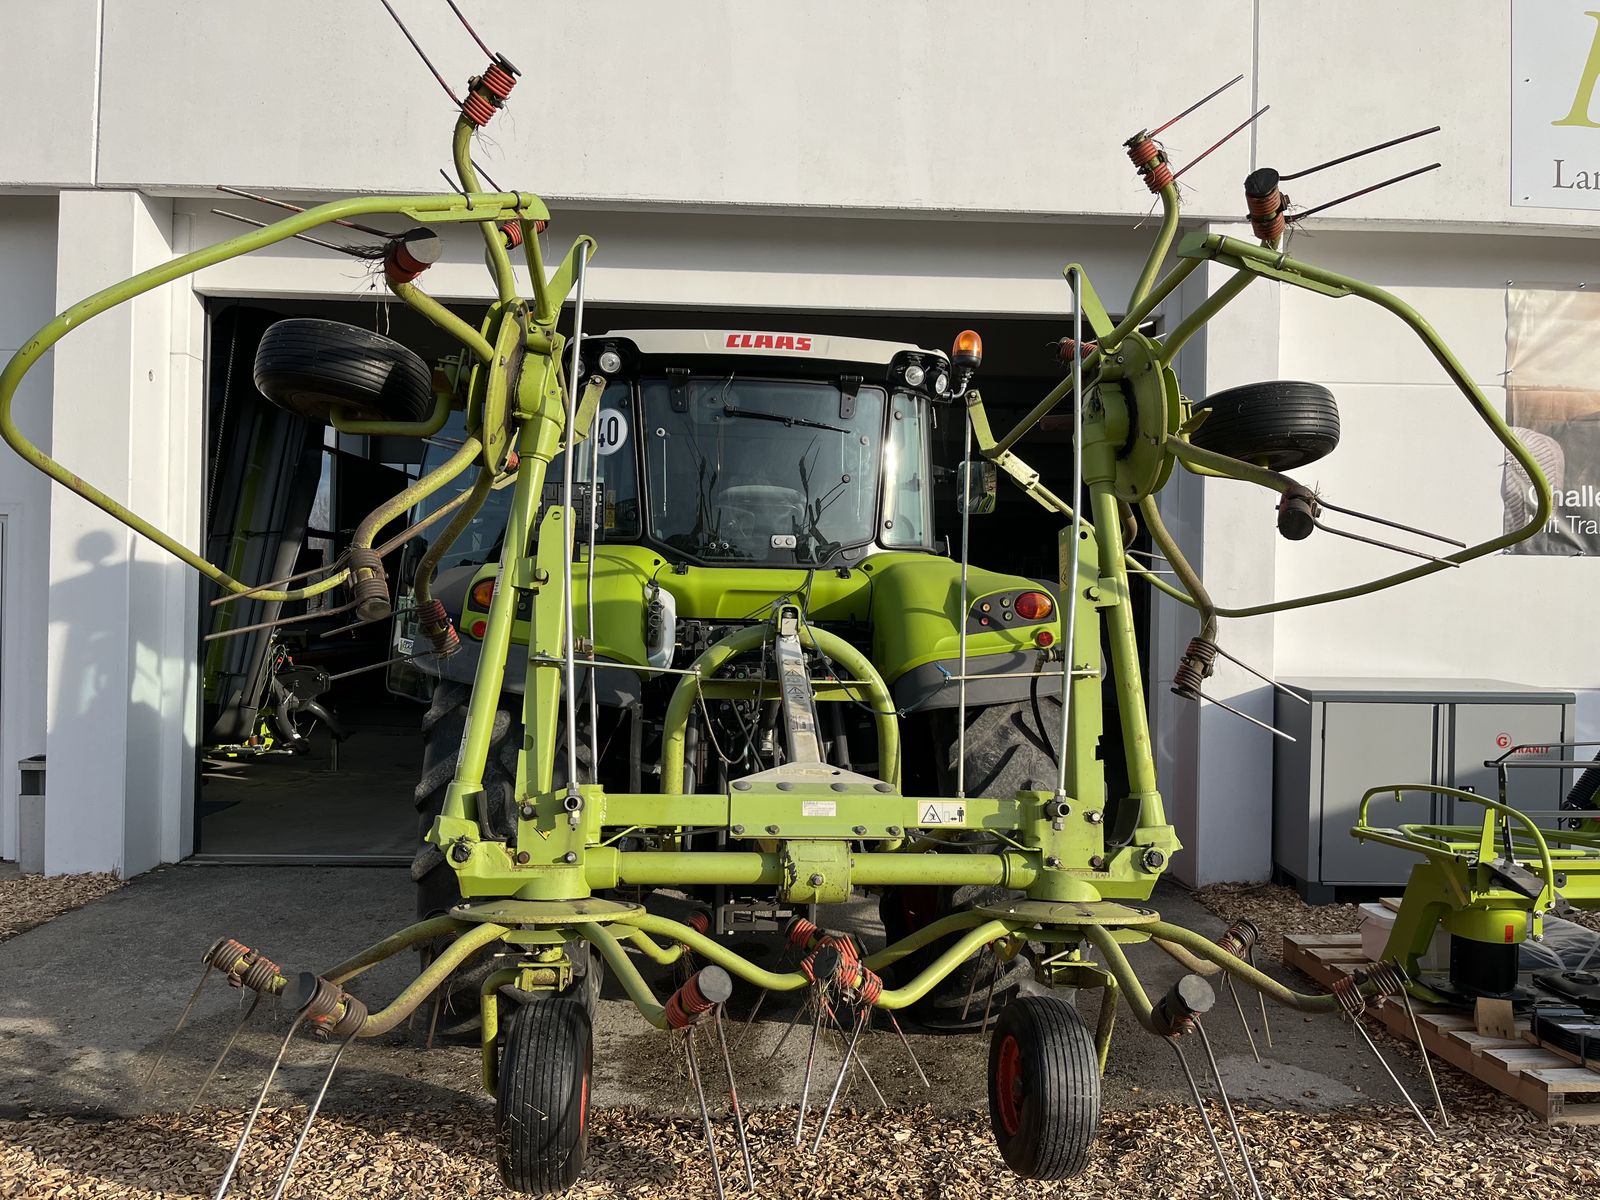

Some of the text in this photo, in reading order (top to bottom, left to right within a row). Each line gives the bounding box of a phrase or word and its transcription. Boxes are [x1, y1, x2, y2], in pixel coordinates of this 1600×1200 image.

[726, 334, 812, 351] CLAAS
[1565, 515, 1600, 535] Tra
[1510, 745, 1550, 754] RANIT
